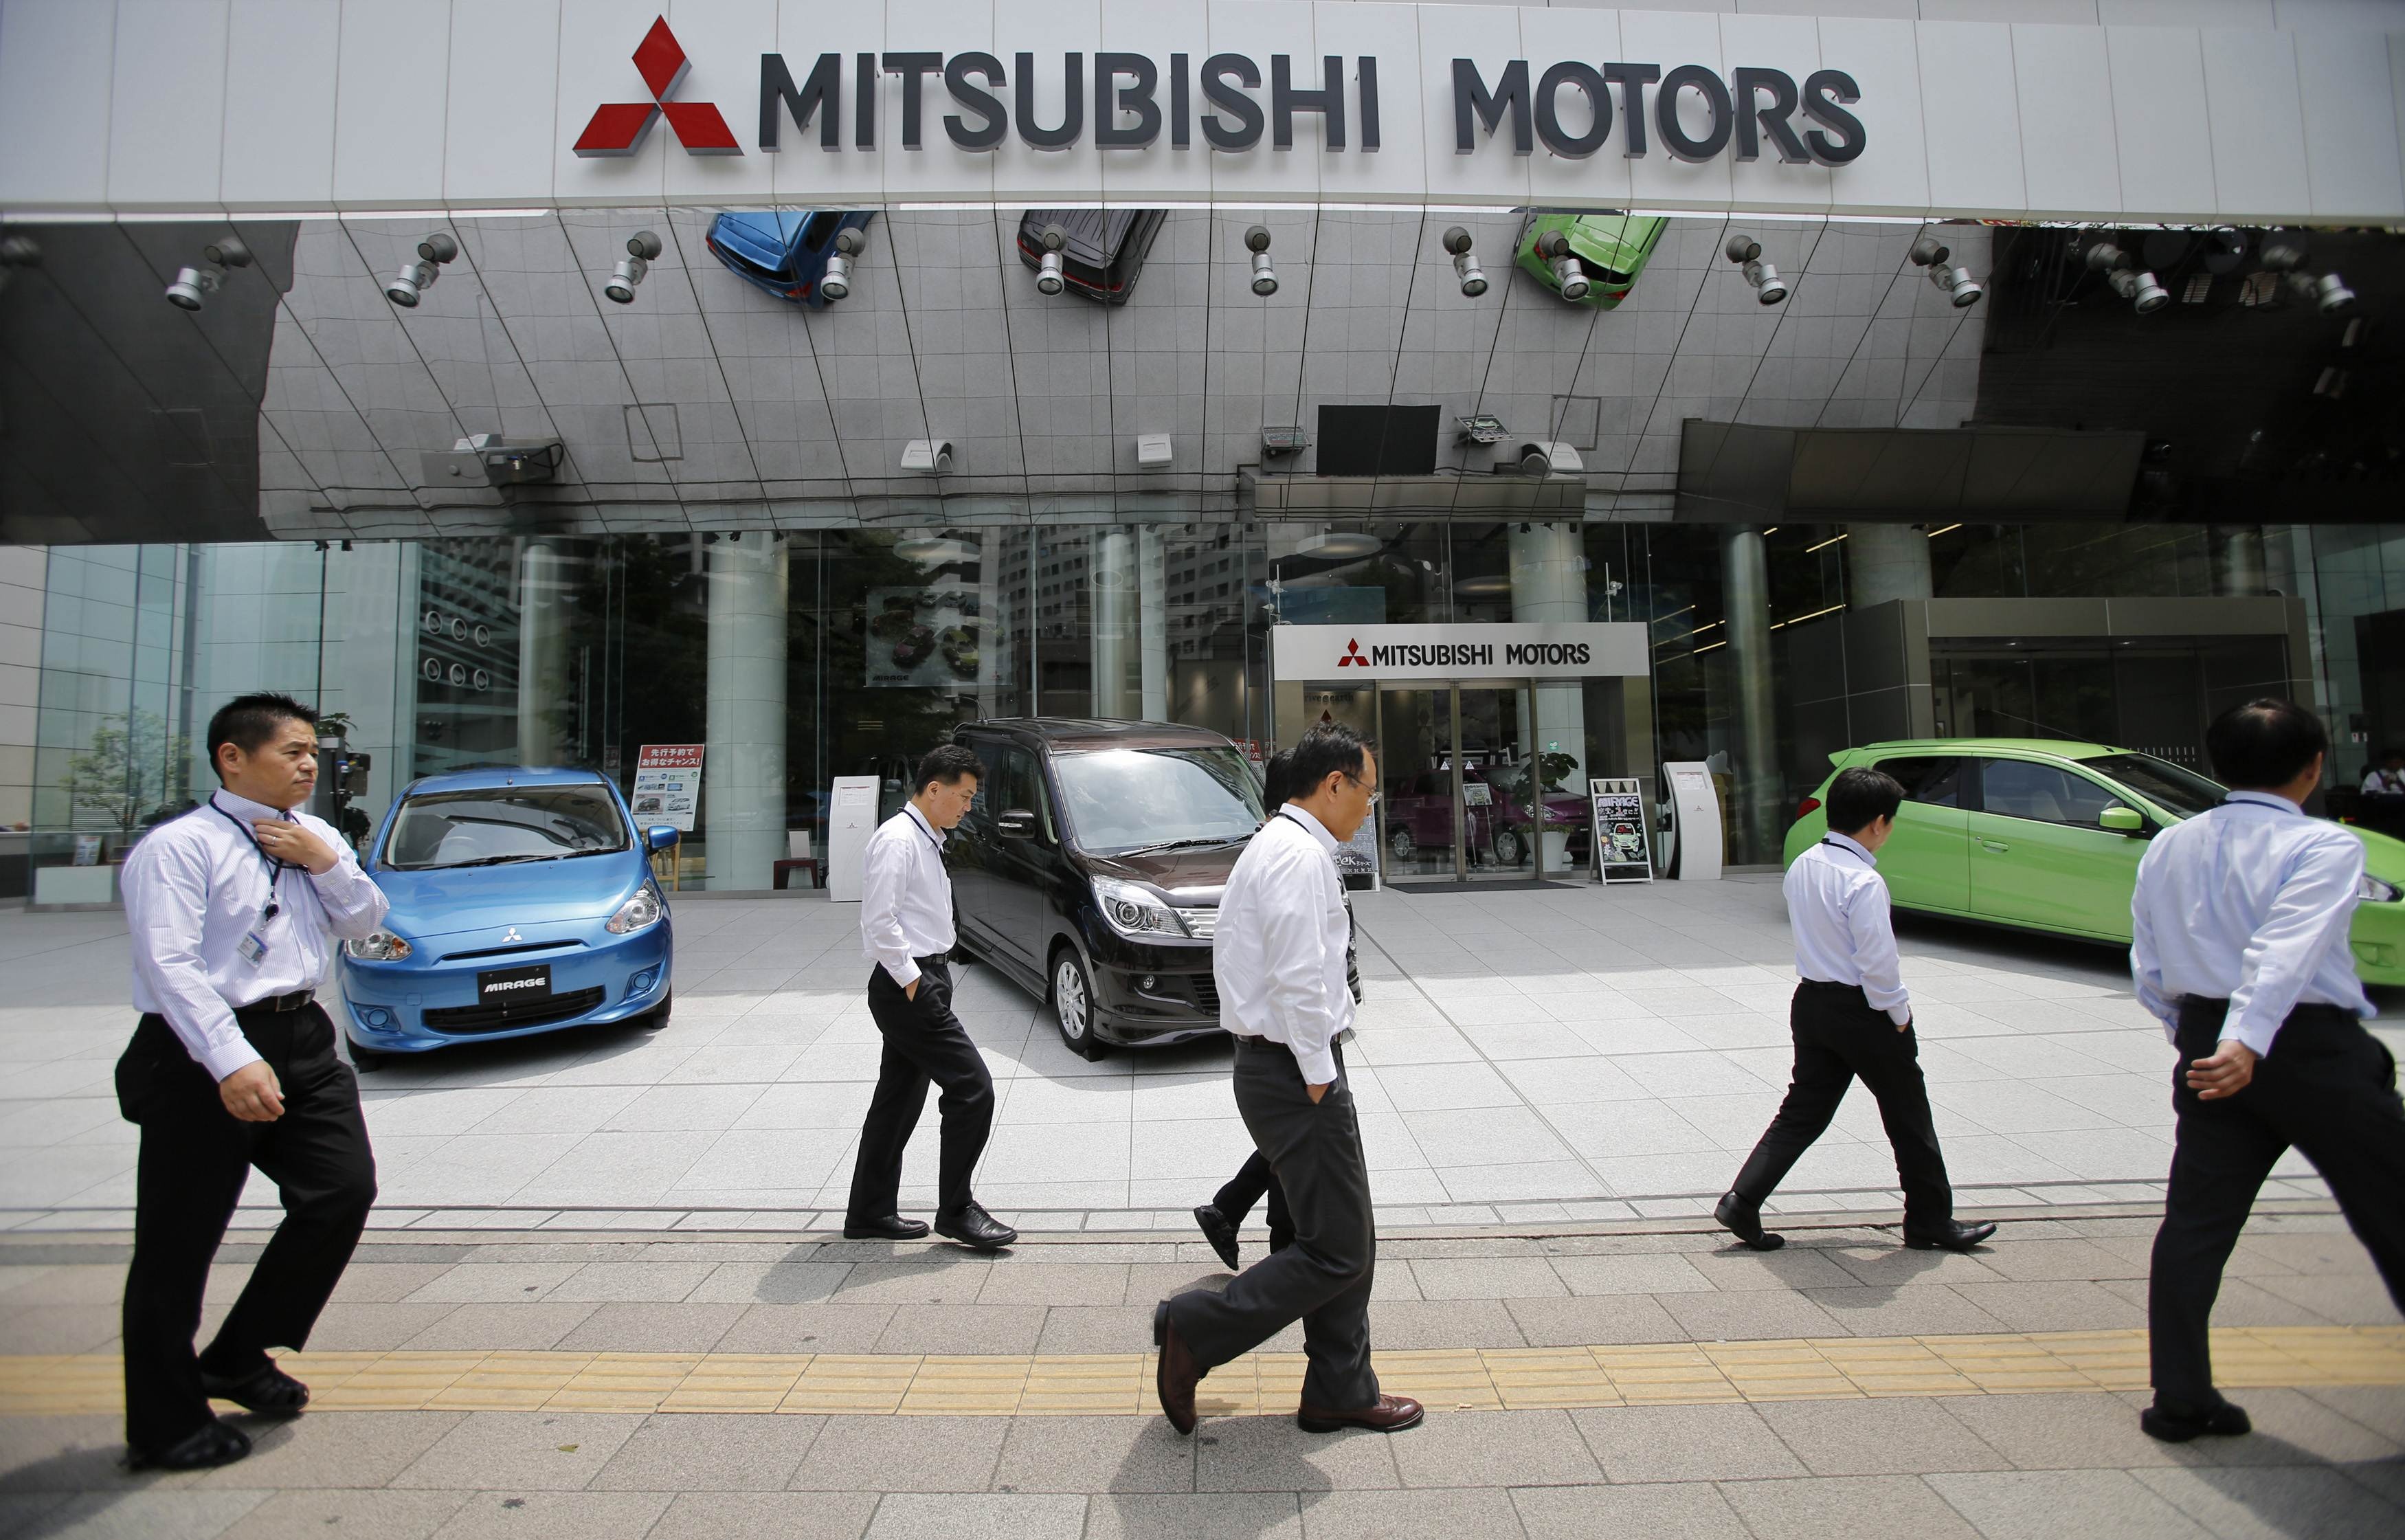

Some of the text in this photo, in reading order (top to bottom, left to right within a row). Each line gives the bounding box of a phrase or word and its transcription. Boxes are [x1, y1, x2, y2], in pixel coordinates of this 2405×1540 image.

[759, 52, 1866, 167] MITSUBISHI MOTORS
[1372, 643, 1590, 666] MITSUBISHI MOTORS
[1305, 693, 1354, 704] rive@earth
[651, 748, 695, 757] 先行予約で
[642, 758, 700, 766] お得なチャンス!
[1598, 796, 1639, 807] MIRAGE
[484, 977, 546, 992] MIRAGE
